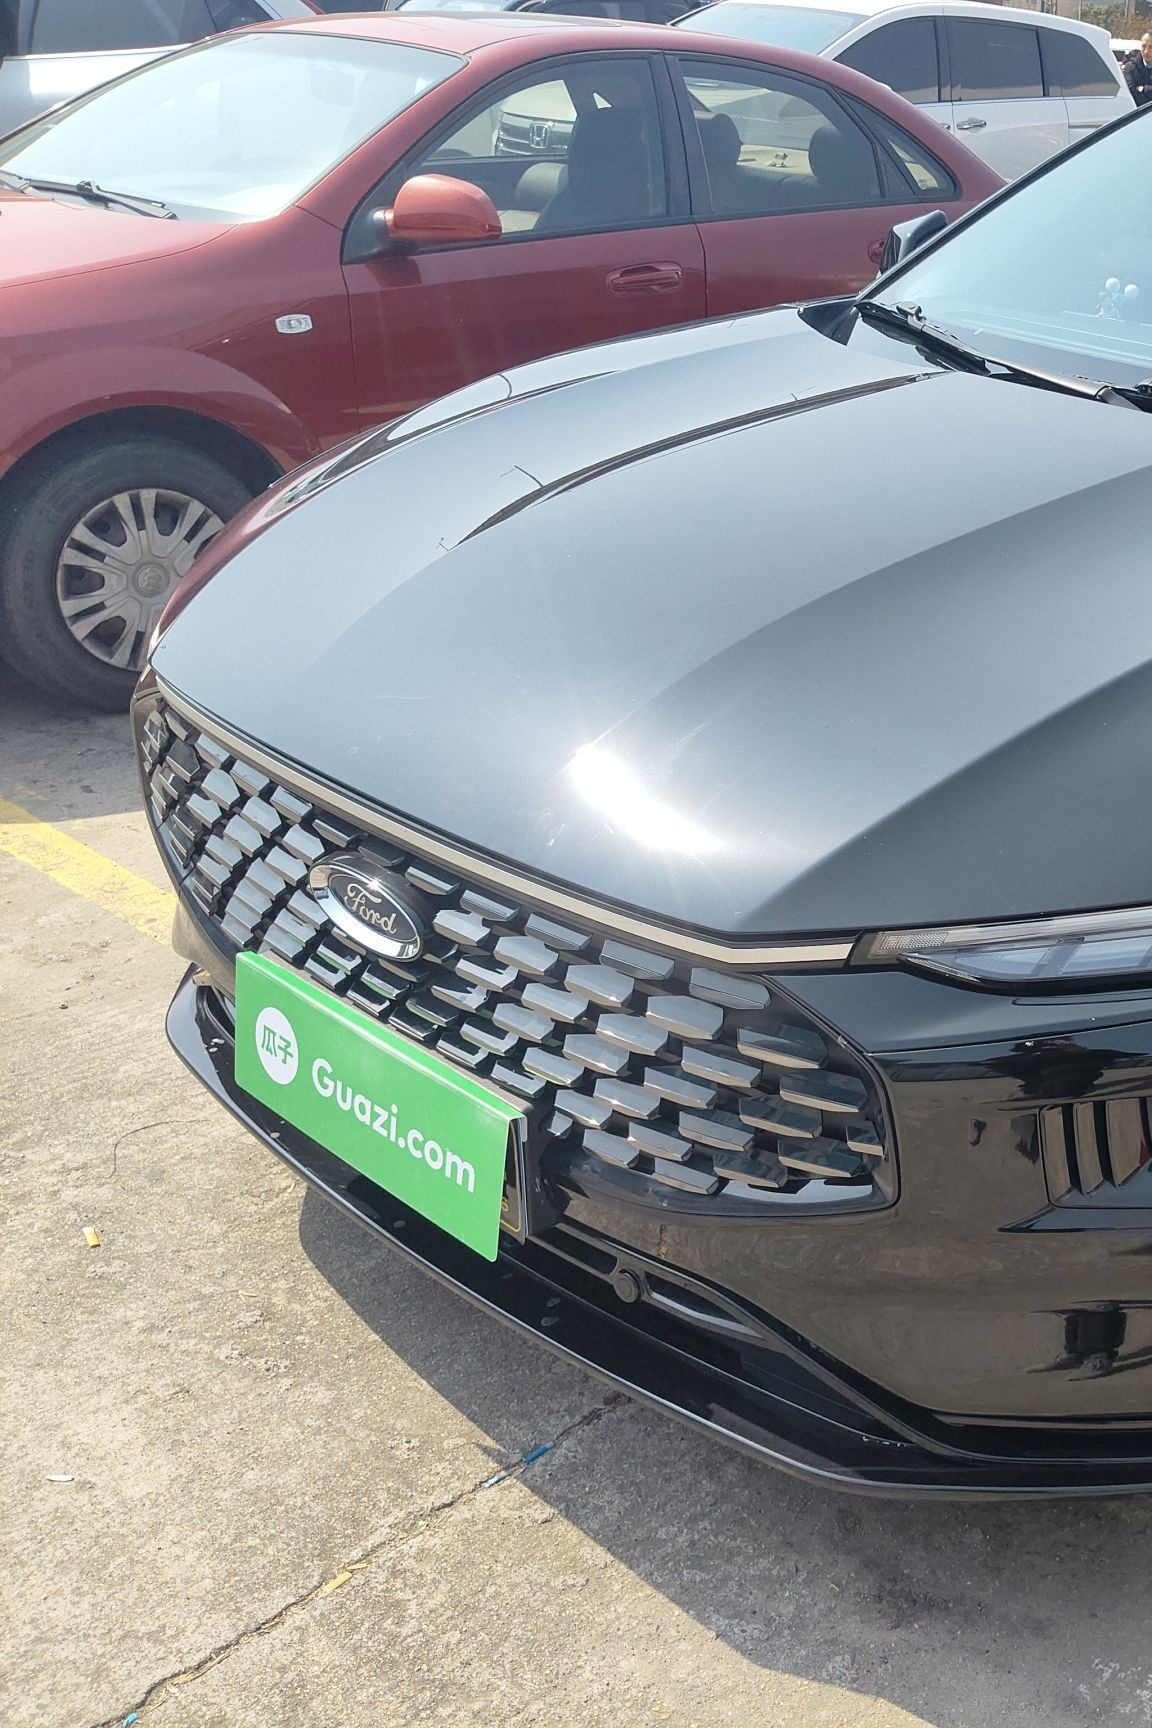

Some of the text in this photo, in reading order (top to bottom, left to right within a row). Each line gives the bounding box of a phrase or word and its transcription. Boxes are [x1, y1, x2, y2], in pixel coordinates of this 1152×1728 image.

[344, 883, 397, 934] Ford
[261, 1024, 294, 1064] 瓜子
[312, 1058, 475, 1193] Guazi.com
